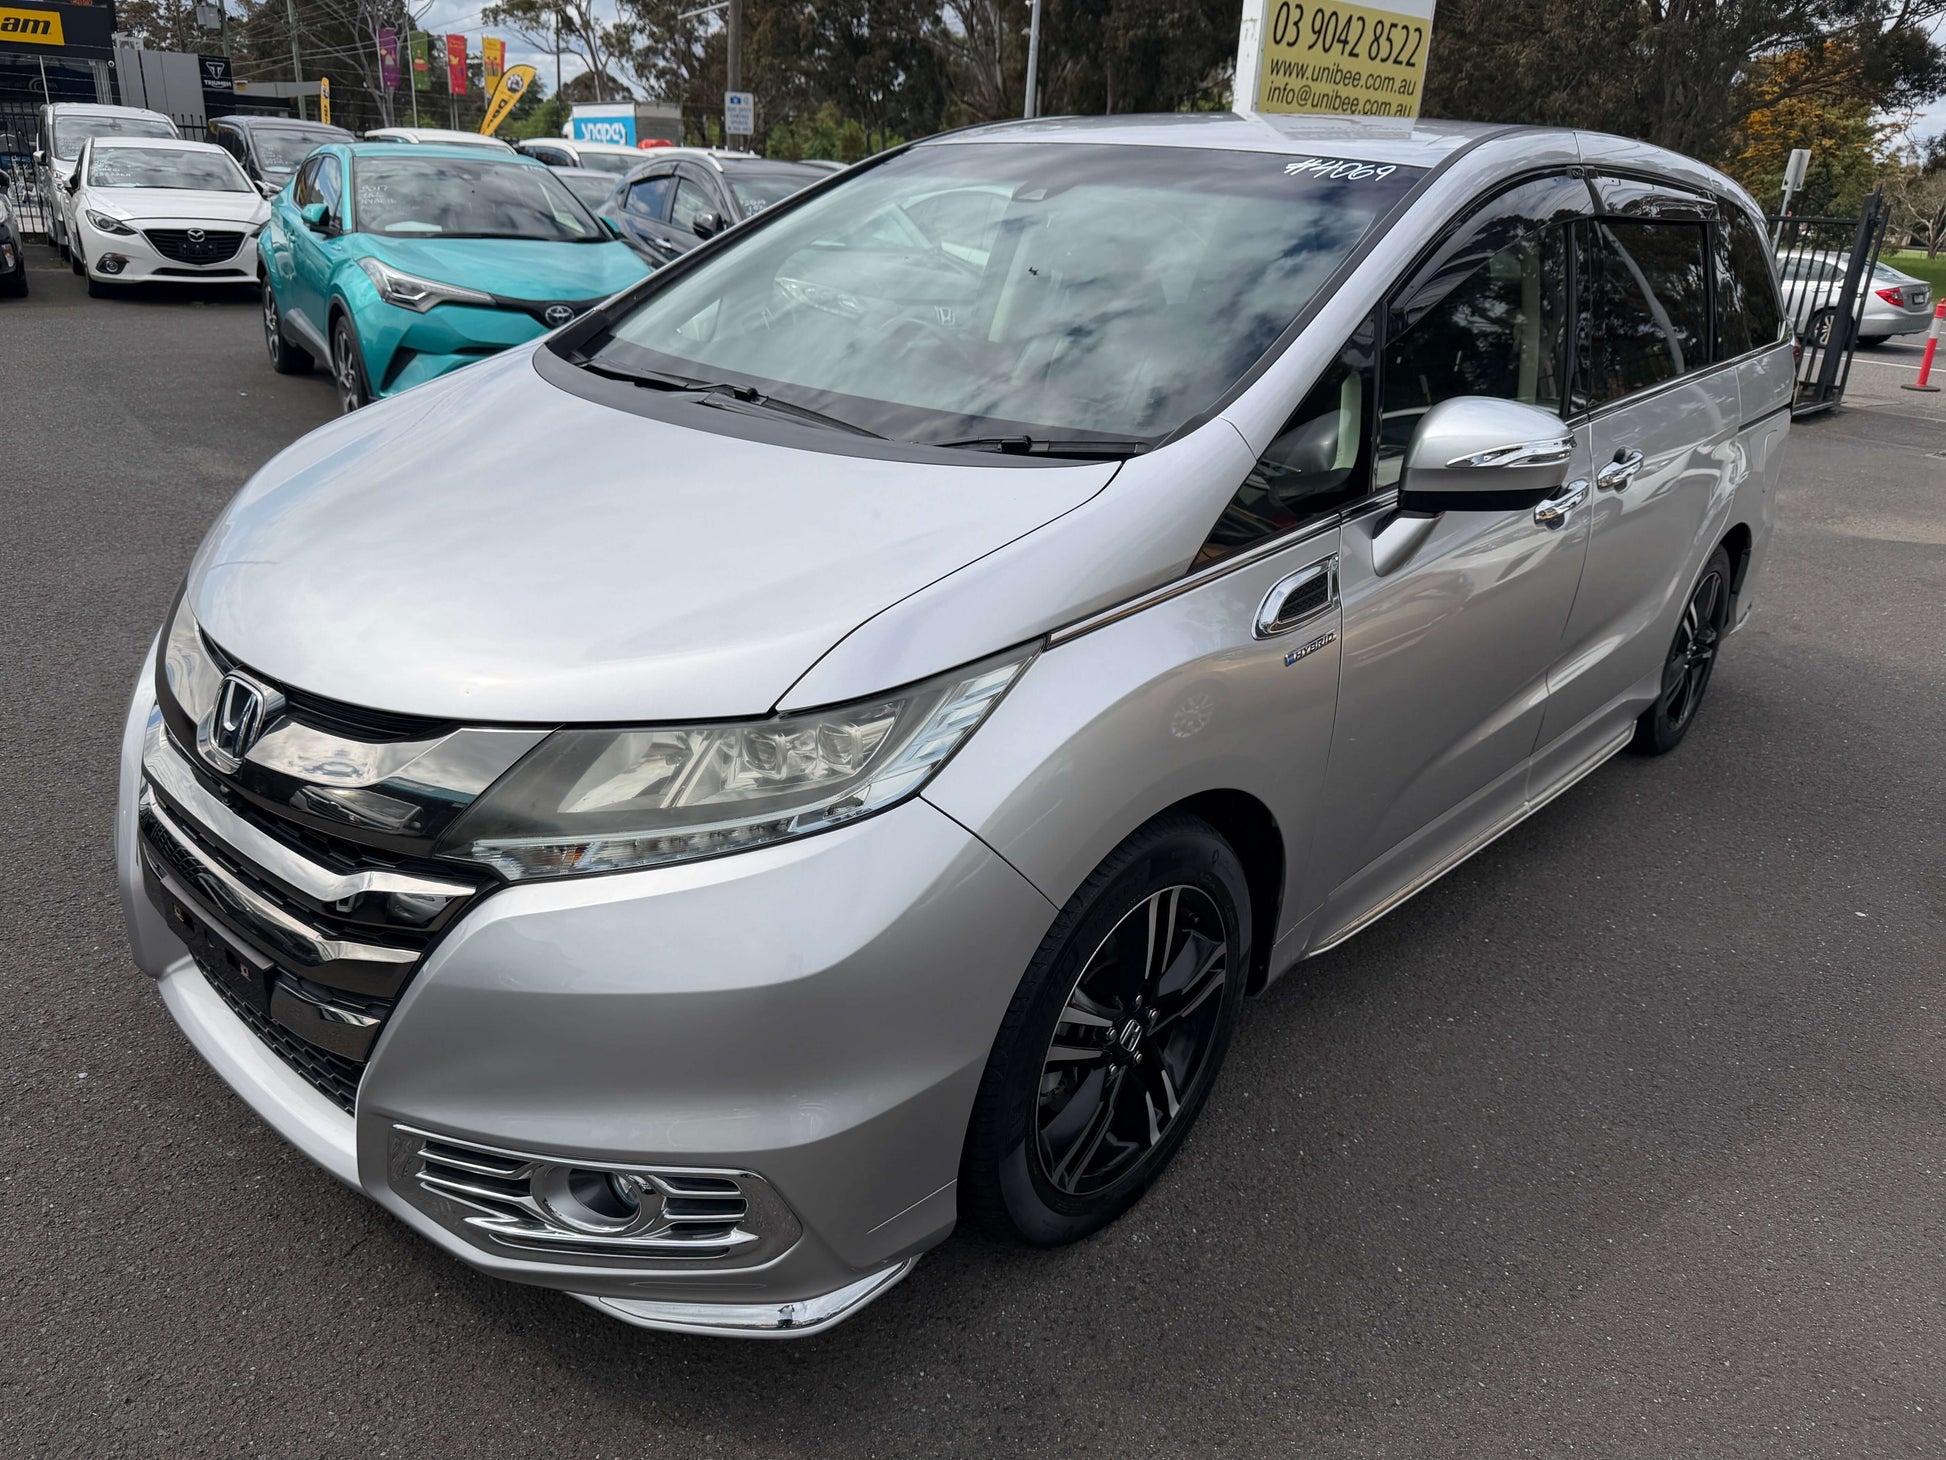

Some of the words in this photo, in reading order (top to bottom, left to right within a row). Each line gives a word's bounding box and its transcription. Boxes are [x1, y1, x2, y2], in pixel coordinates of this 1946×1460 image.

[1273, 1, 1304, 47] 03
[1308, 8, 1366, 58] 9042
[1368, 20, 1423, 68] 8522
[1270, 58, 1416, 96] www.unibee.com.au
[1267, 80, 1413, 117] info@unibee.com.au
[1293, 632, 1333, 662] HYBRID
